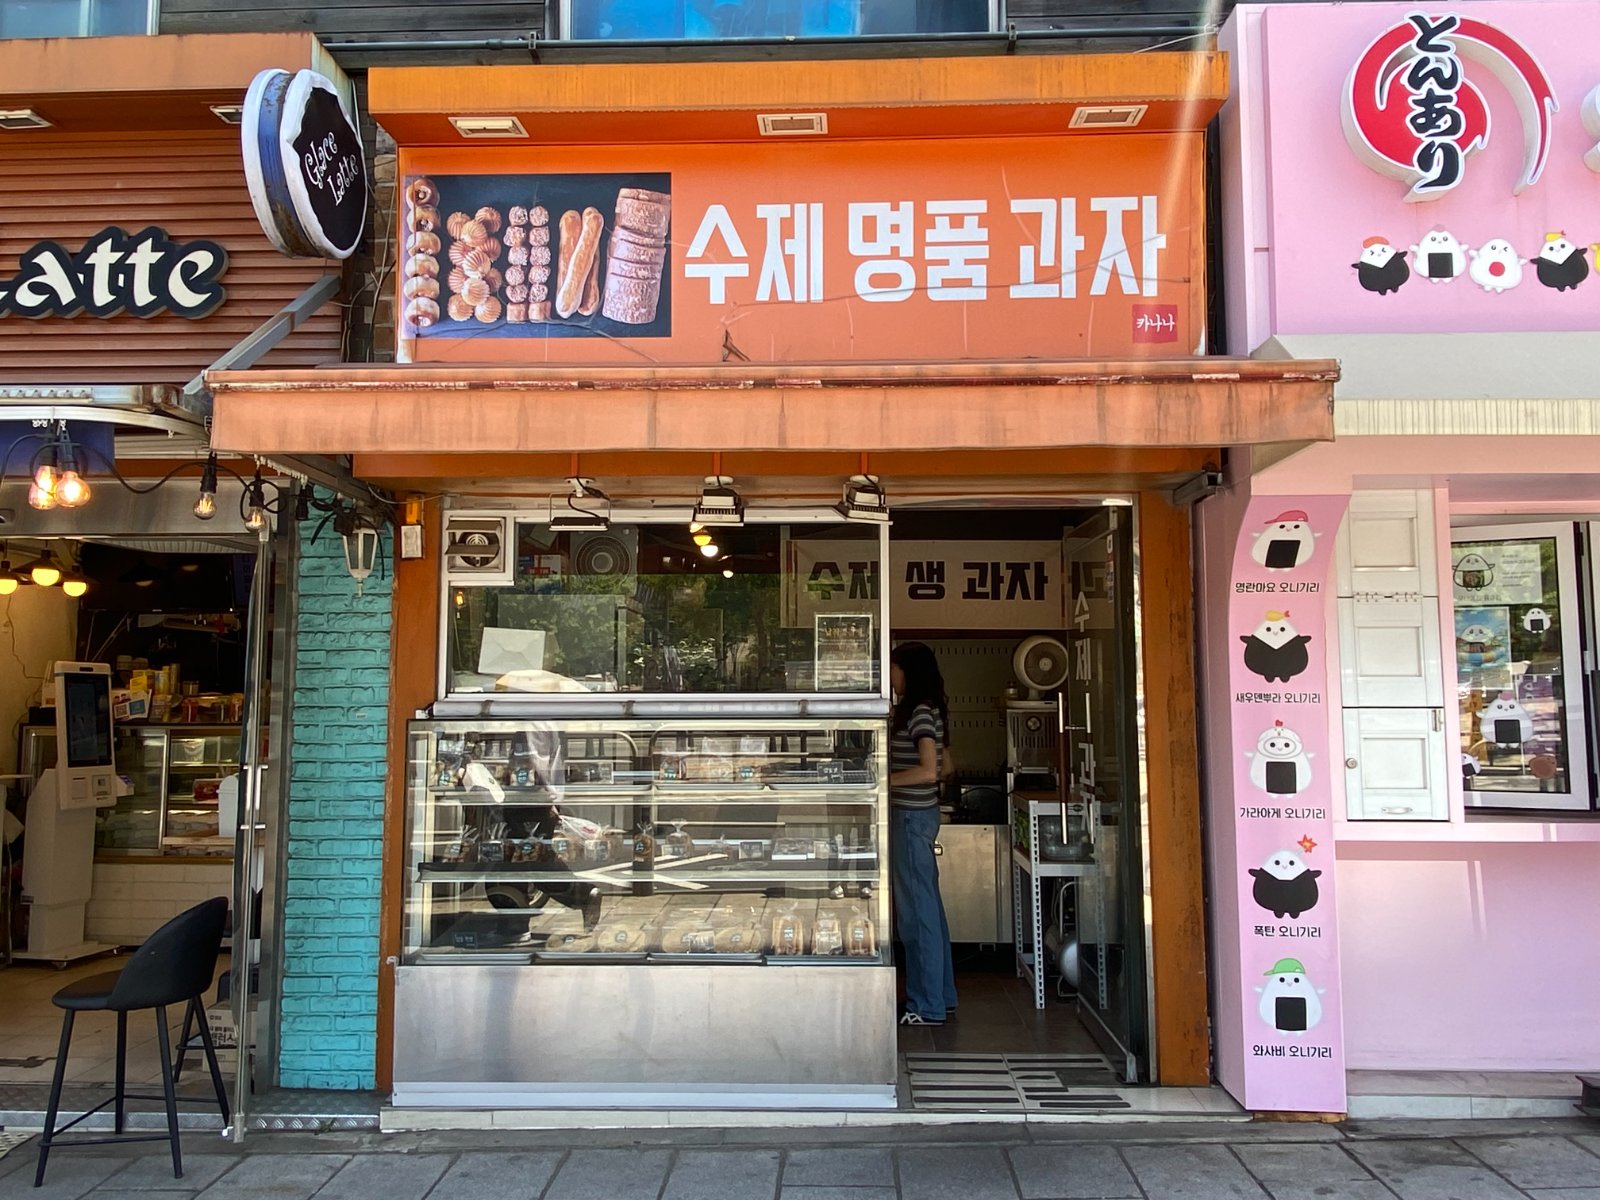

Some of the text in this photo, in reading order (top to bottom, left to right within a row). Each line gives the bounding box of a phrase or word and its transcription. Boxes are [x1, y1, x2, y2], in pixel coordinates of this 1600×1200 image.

[1407, 15, 1462, 190] とんあり
[304, 131, 338, 190] Glace
[326, 154, 359, 206] Latte
[684, 195, 1167, 305] 수제 명품 과자
[0, 237, 214, 308] atte
[1136, 313, 1176, 333] 카나나
[904, 560, 946, 601] 생
[961, 561, 1049, 601] 과자
[1235, 582, 1320, 594] 명란마요 오니기리
[1284, 692, 1321, 704] 오니기리
[1239, 807, 1326, 820] 가라아게 오니기리
[1253, 925, 1321, 938] 폭탄 오니기리
[1252, 1044, 1332, 1059] 와사비 오니기리
